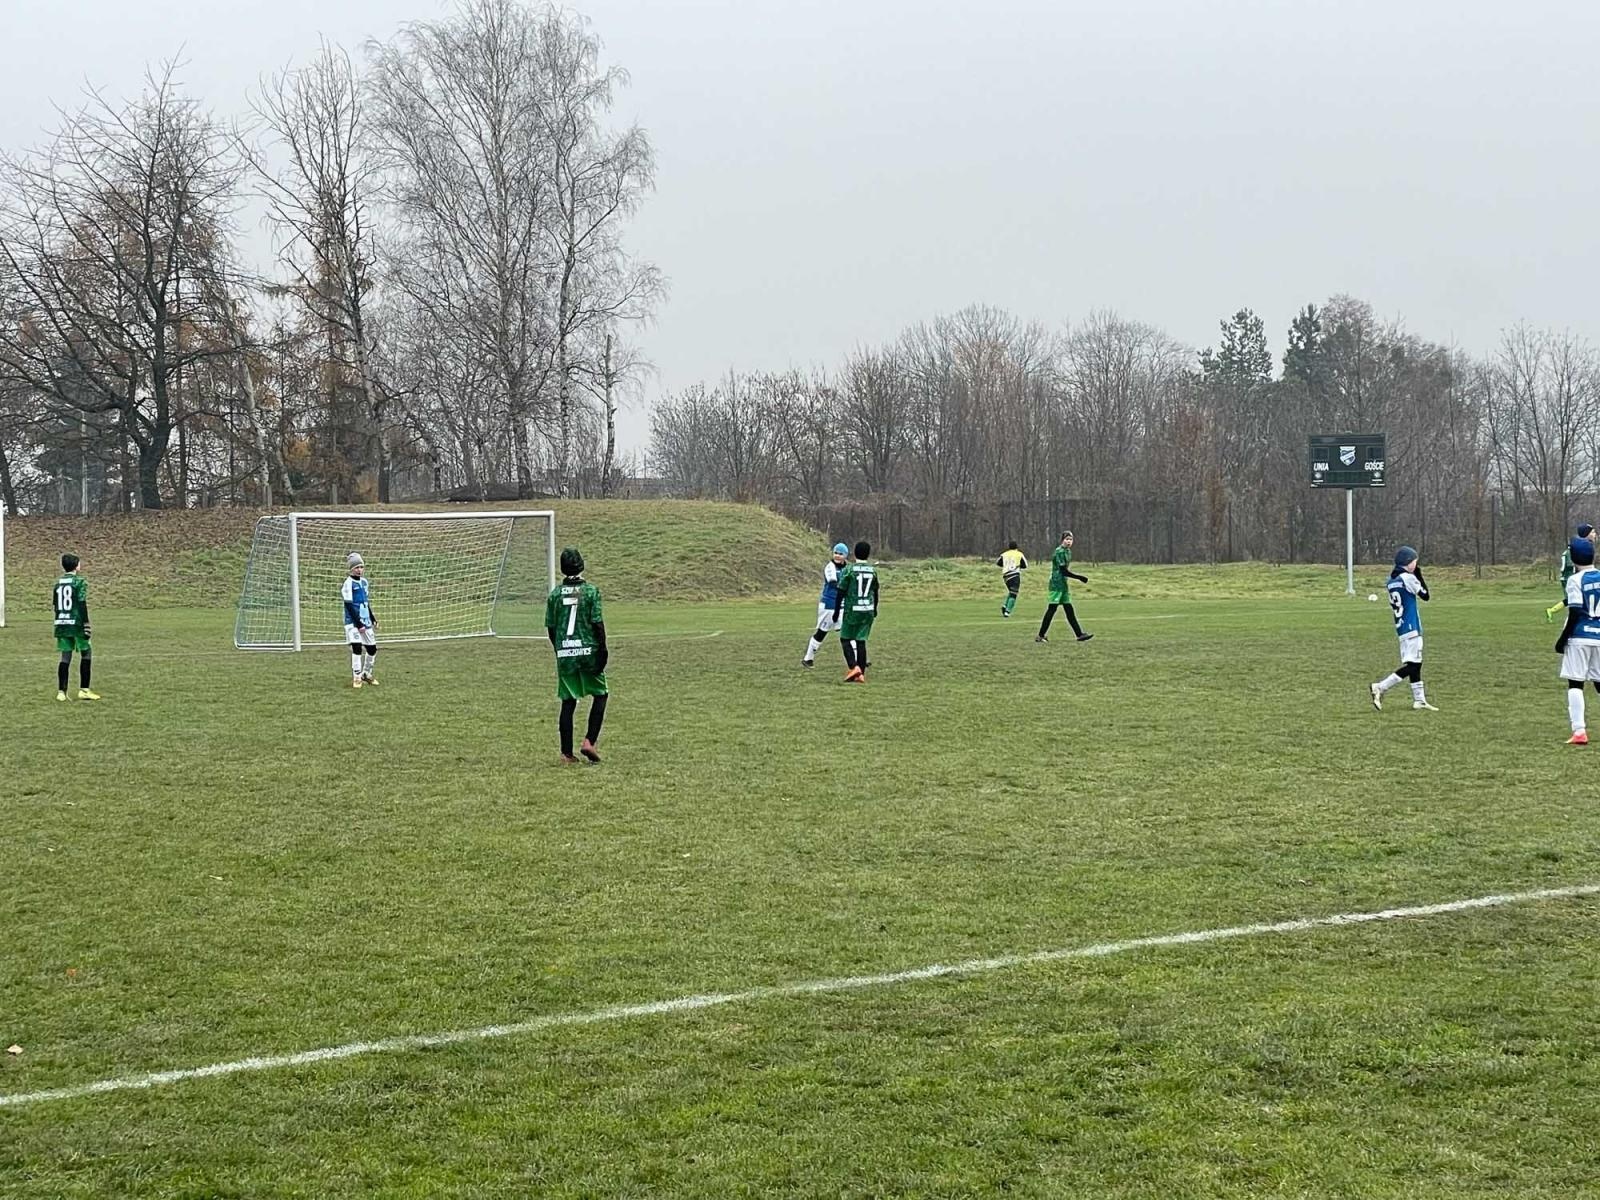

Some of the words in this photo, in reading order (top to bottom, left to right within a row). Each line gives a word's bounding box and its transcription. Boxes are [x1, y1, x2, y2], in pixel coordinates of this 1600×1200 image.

[1313, 462, 1330, 471] UNIA
[1364, 460, 1385, 471] GOŚCIE
[56, 585, 73, 611] 18
[856, 573, 874, 598] 17
[562, 597, 579, 636] 7
